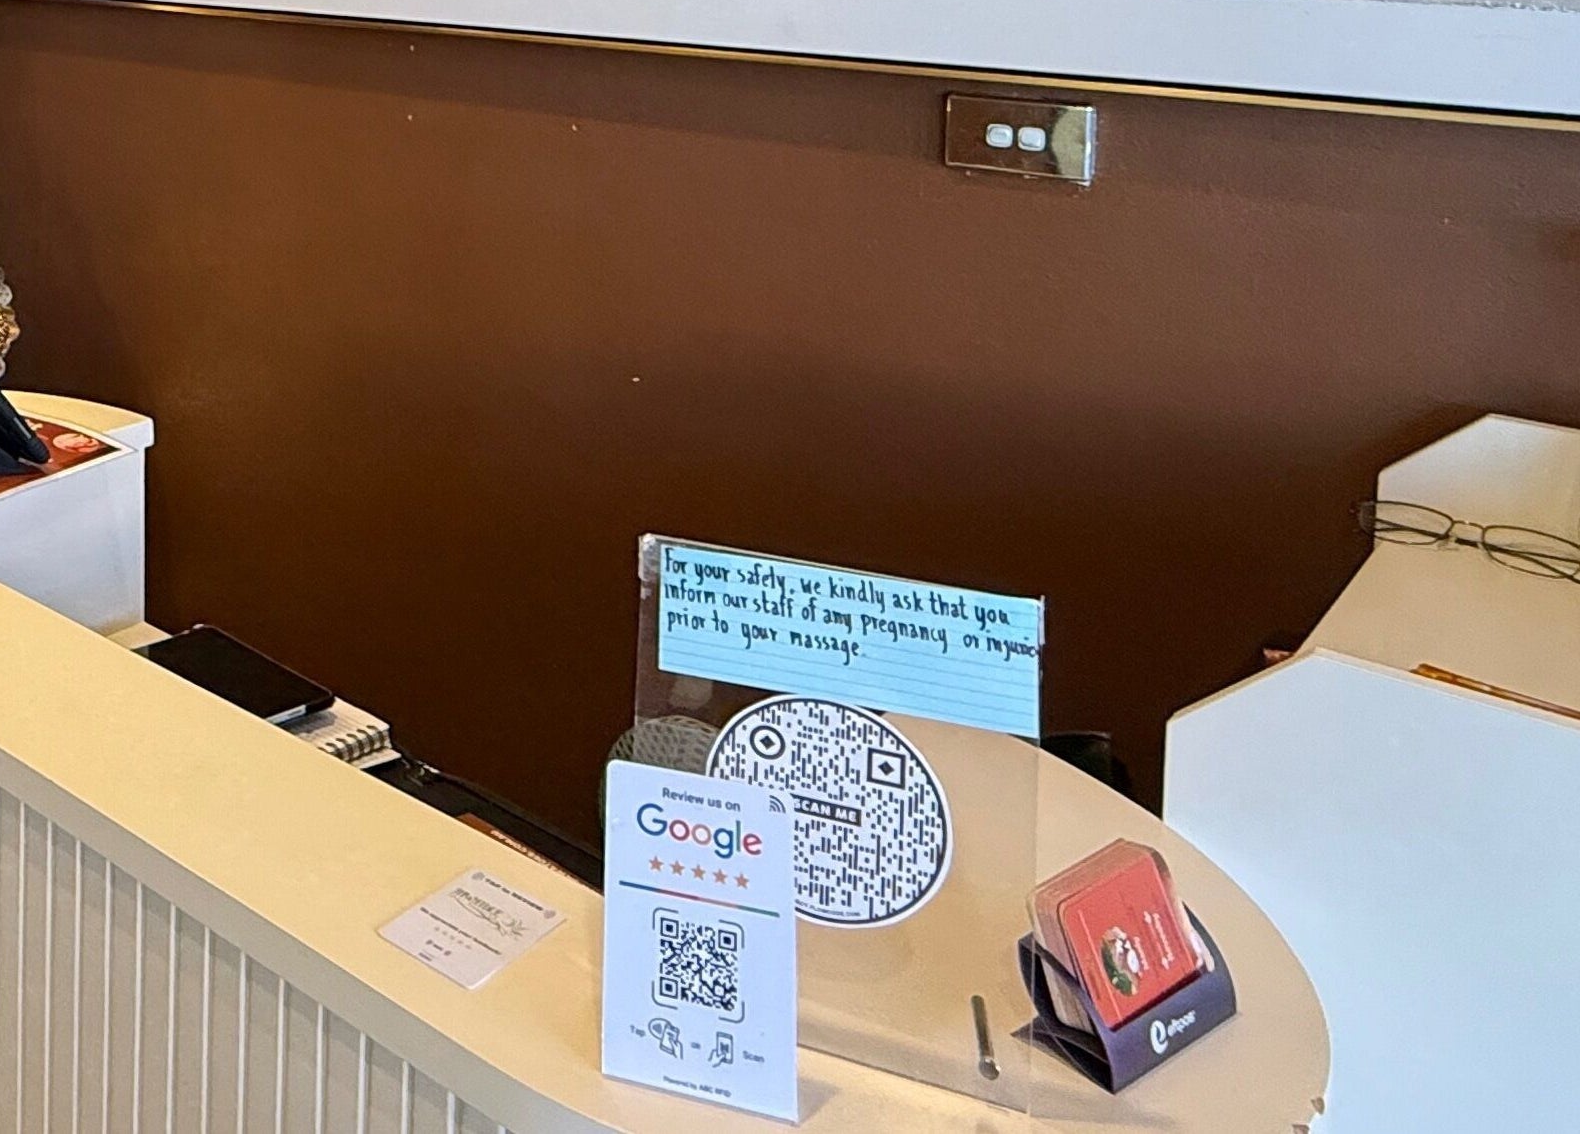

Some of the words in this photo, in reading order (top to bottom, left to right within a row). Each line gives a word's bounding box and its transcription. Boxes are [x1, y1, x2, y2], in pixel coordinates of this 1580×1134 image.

[665, 547, 688, 573] For
[694, 563, 731, 586] your
[799, 578, 822, 595] we
[828, 576, 885, 613] kindly
[892, 591, 924, 612] ask
[929, 591, 969, 620] that
[974, 605, 1011, 631] you
[664, 579, 717, 604] inform
[722, 594, 748, 609] our
[754, 590, 795, 618] staff
[801, 597, 818, 622] of
[823, 609, 853, 634] any
[860, 614, 949, 654] pregnancy
[962, 633, 980, 649] or
[667, 608, 706, 632] prior
[712, 610, 730, 633] to
[740, 622, 778, 650] your
[662, 787, 704, 805] Review
[707, 797, 722, 808] us
[725, 801, 741, 812] on
[835, 807, 857, 822] ME
[636, 803, 763, 859] Google
[742, 1049, 766, 1063] Scan
